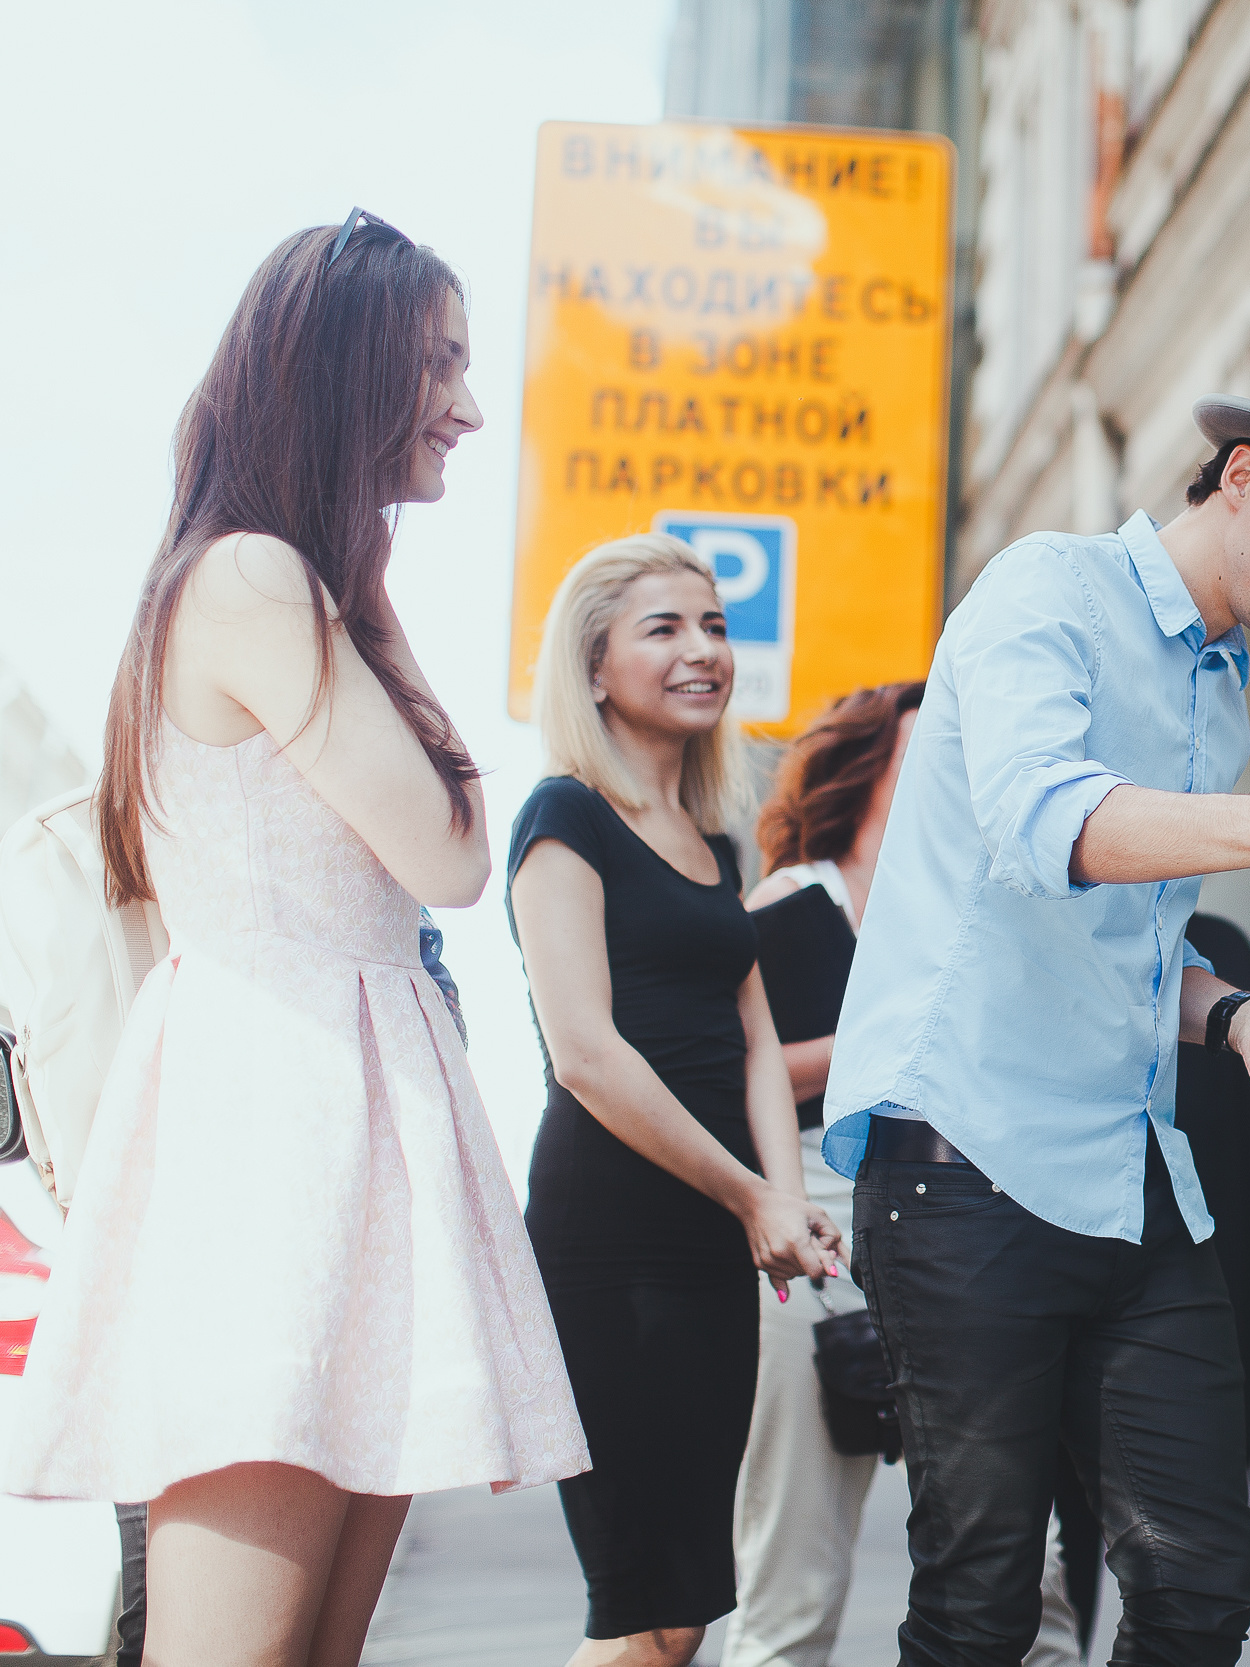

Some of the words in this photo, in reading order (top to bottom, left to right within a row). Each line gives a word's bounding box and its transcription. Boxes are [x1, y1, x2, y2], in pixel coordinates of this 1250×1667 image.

[563, 134, 925, 202] ВНИМАНИЕ!
[692, 204, 787, 251] ВЫ
[535, 261, 936, 324] НАХОДИТЕСЬ
[629, 328, 661, 373] В
[692, 332, 841, 385] ЗОНЕ
[591, 387, 875, 445] ПЛАТНОЙ
[564, 450, 897, 510] ПАРКОВКИ
[692, 530, 769, 602] P
